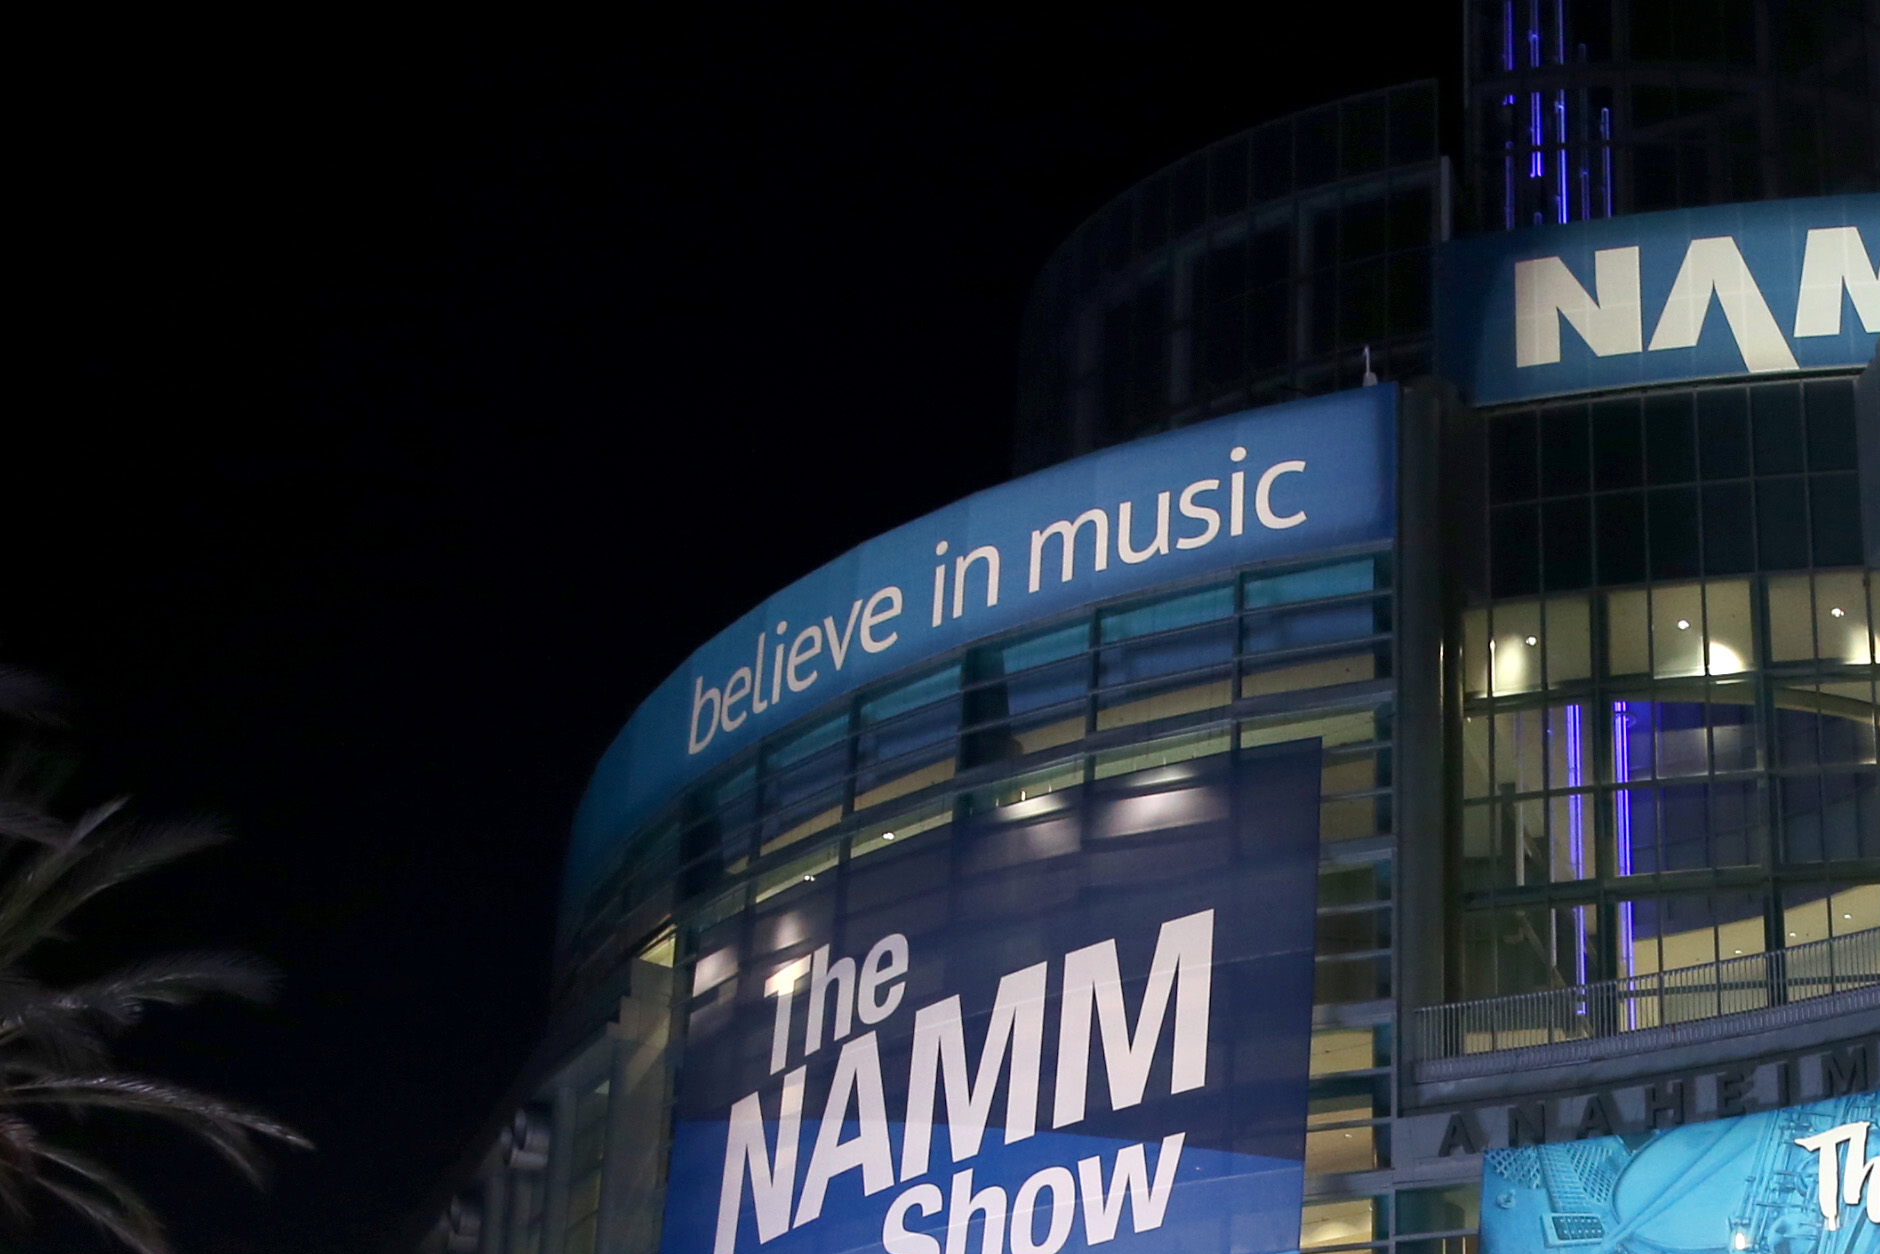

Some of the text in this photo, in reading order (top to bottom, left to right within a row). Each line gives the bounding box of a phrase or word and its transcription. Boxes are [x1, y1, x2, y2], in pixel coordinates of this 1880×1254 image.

[688, 446, 1308, 756] believe in music
[764, 932, 910, 1076] The
[1438, 1043, 1880, 1158] ANAHEIM
